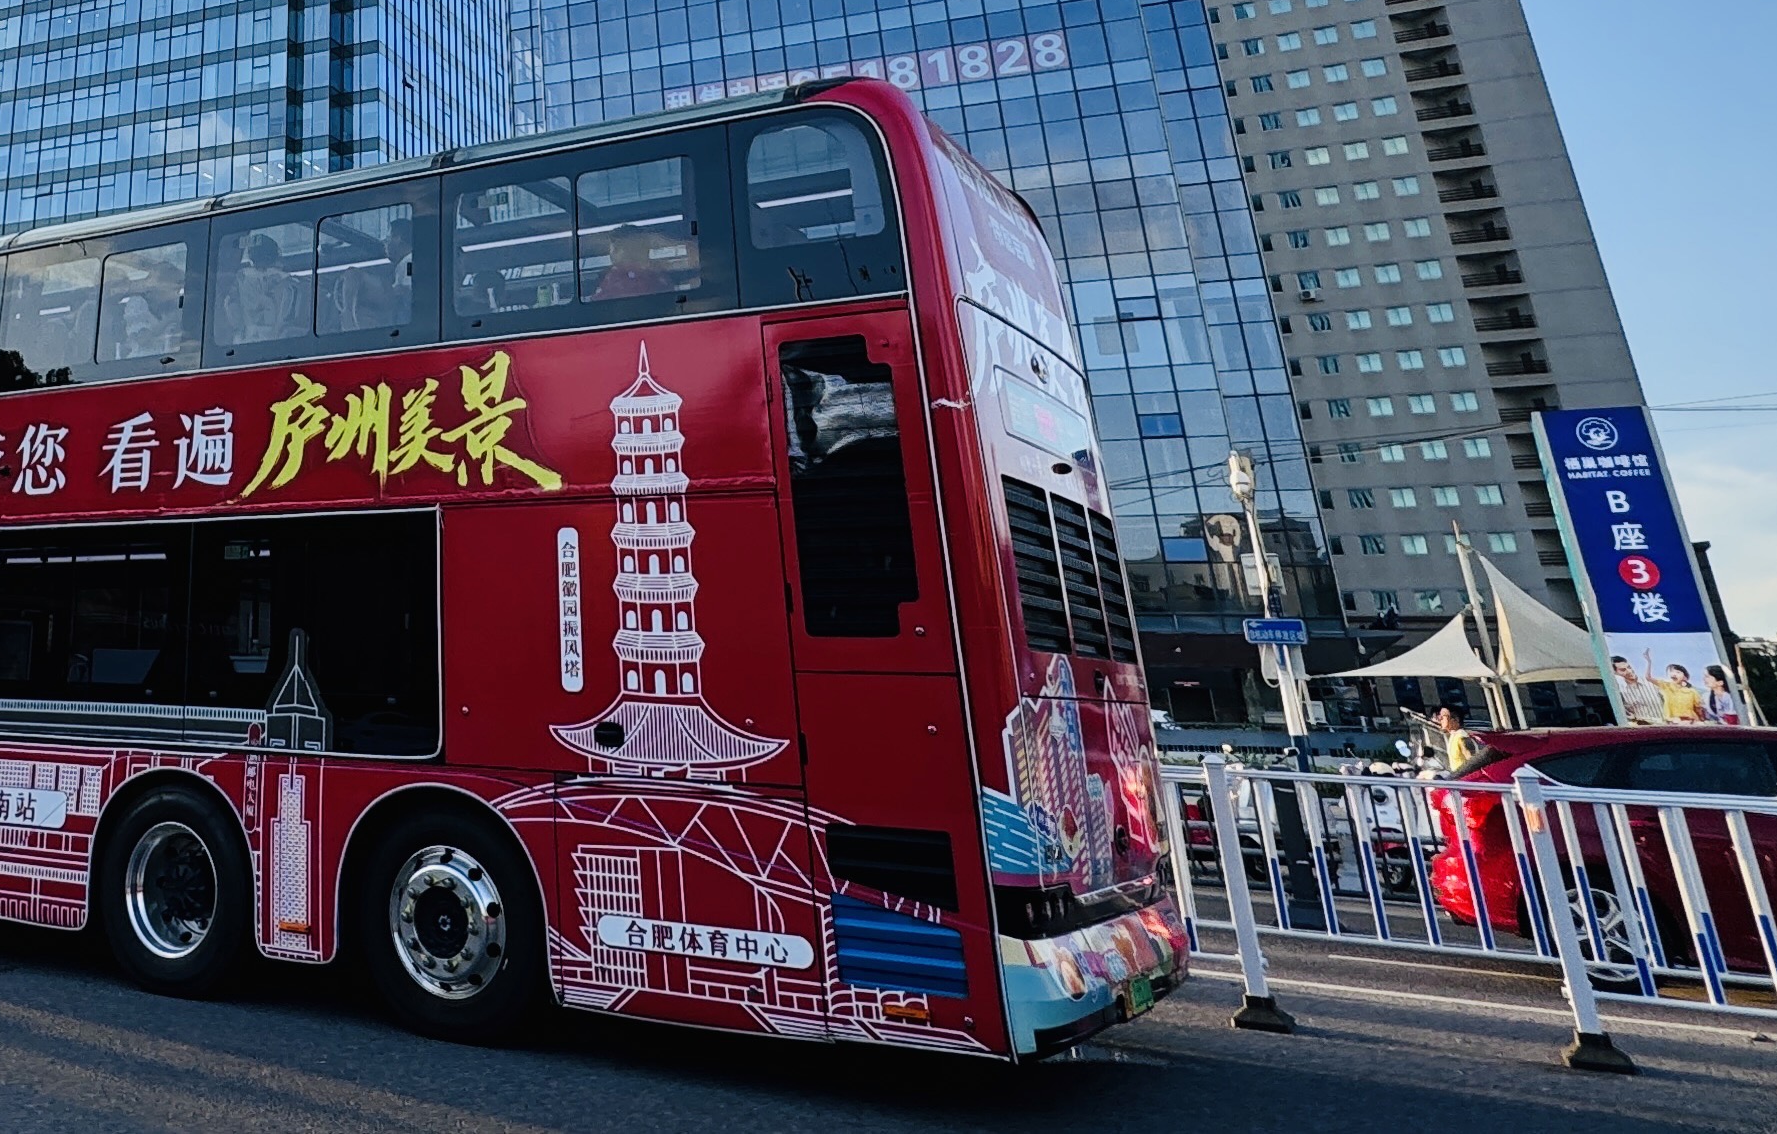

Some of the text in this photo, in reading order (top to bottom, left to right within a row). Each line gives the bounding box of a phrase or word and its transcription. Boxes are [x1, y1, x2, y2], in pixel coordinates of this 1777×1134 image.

[228, 349, 562, 505] 庐州美景
[1612, 468, 1651, 478] COFFEE
[625, 920, 790, 965] 合肥体育中心
